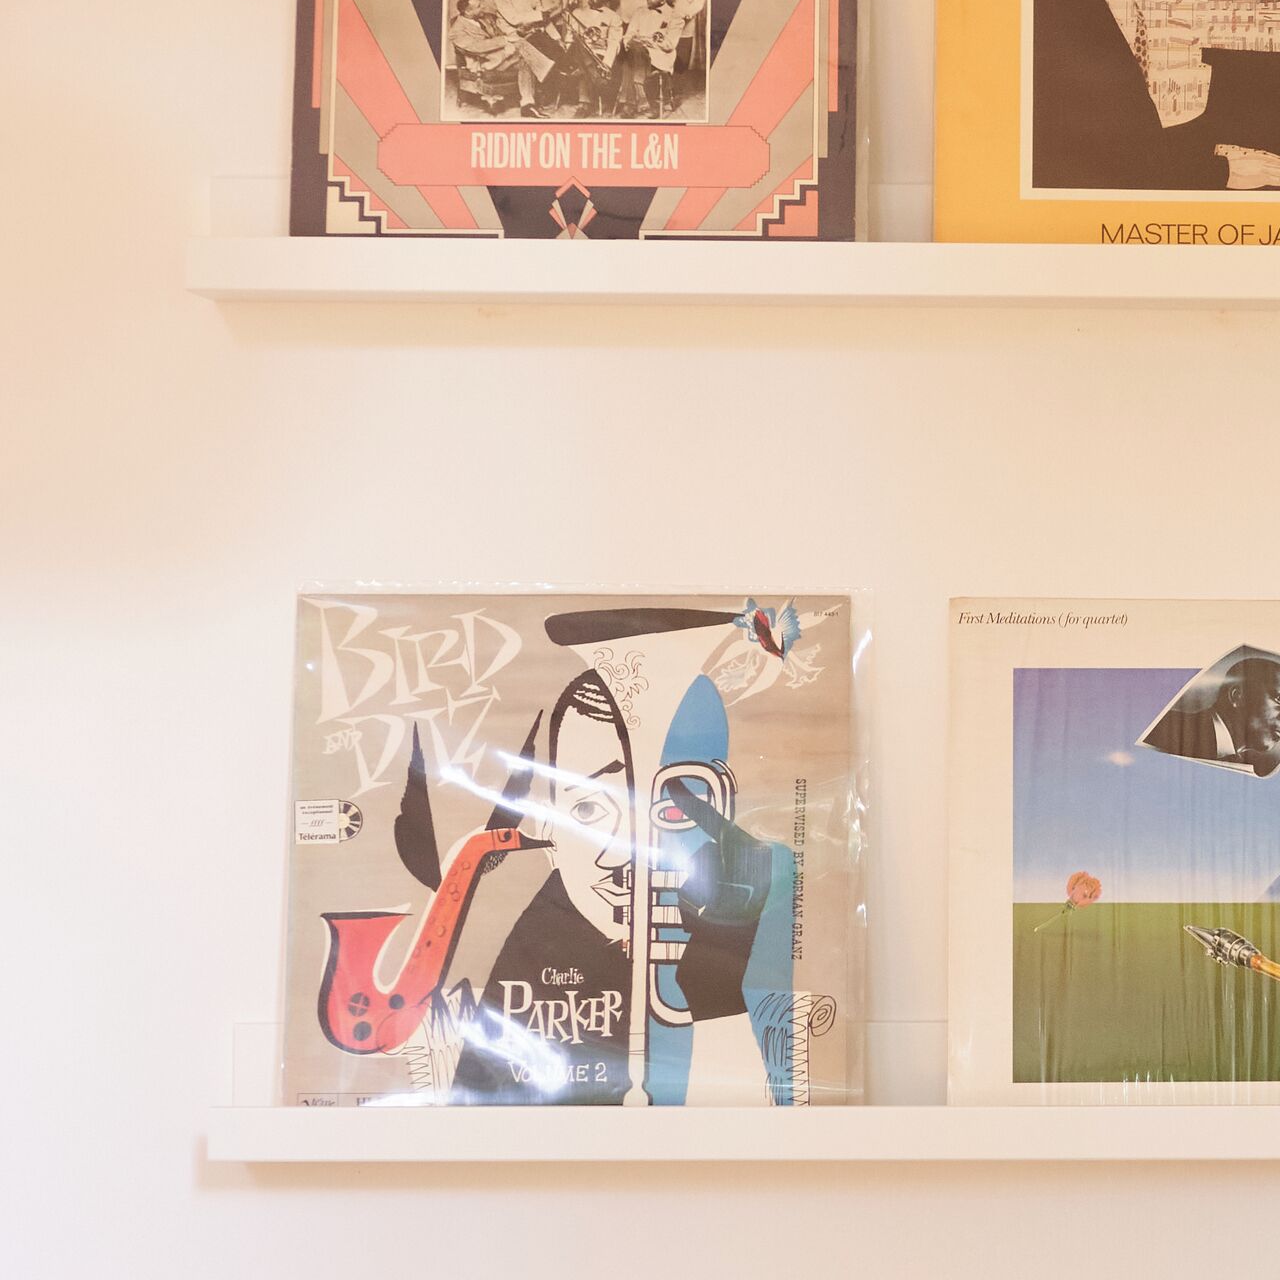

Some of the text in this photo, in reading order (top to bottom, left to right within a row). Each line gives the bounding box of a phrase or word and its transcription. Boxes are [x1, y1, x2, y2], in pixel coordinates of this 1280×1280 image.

[471, 132, 679, 170] RIDIN' ON THE L&N
[1101, 223, 1209, 245] MASTER
[1217, 223, 1256, 245] OF
[958, 611, 985, 625] First
[987, 611, 1056, 625] Meditations
[1083, 612, 1128, 629] quartet)
[302, 596, 523, 725] BIRD
[335, 684, 502, 800] DIZ
[790, 778, 807, 961] SUPERVISED BY NORMAN GRANZ
[541, 966, 585, 986] Charlie
[498, 980, 623, 1045] PARKER
[594, 1061, 608, 1083] 2
